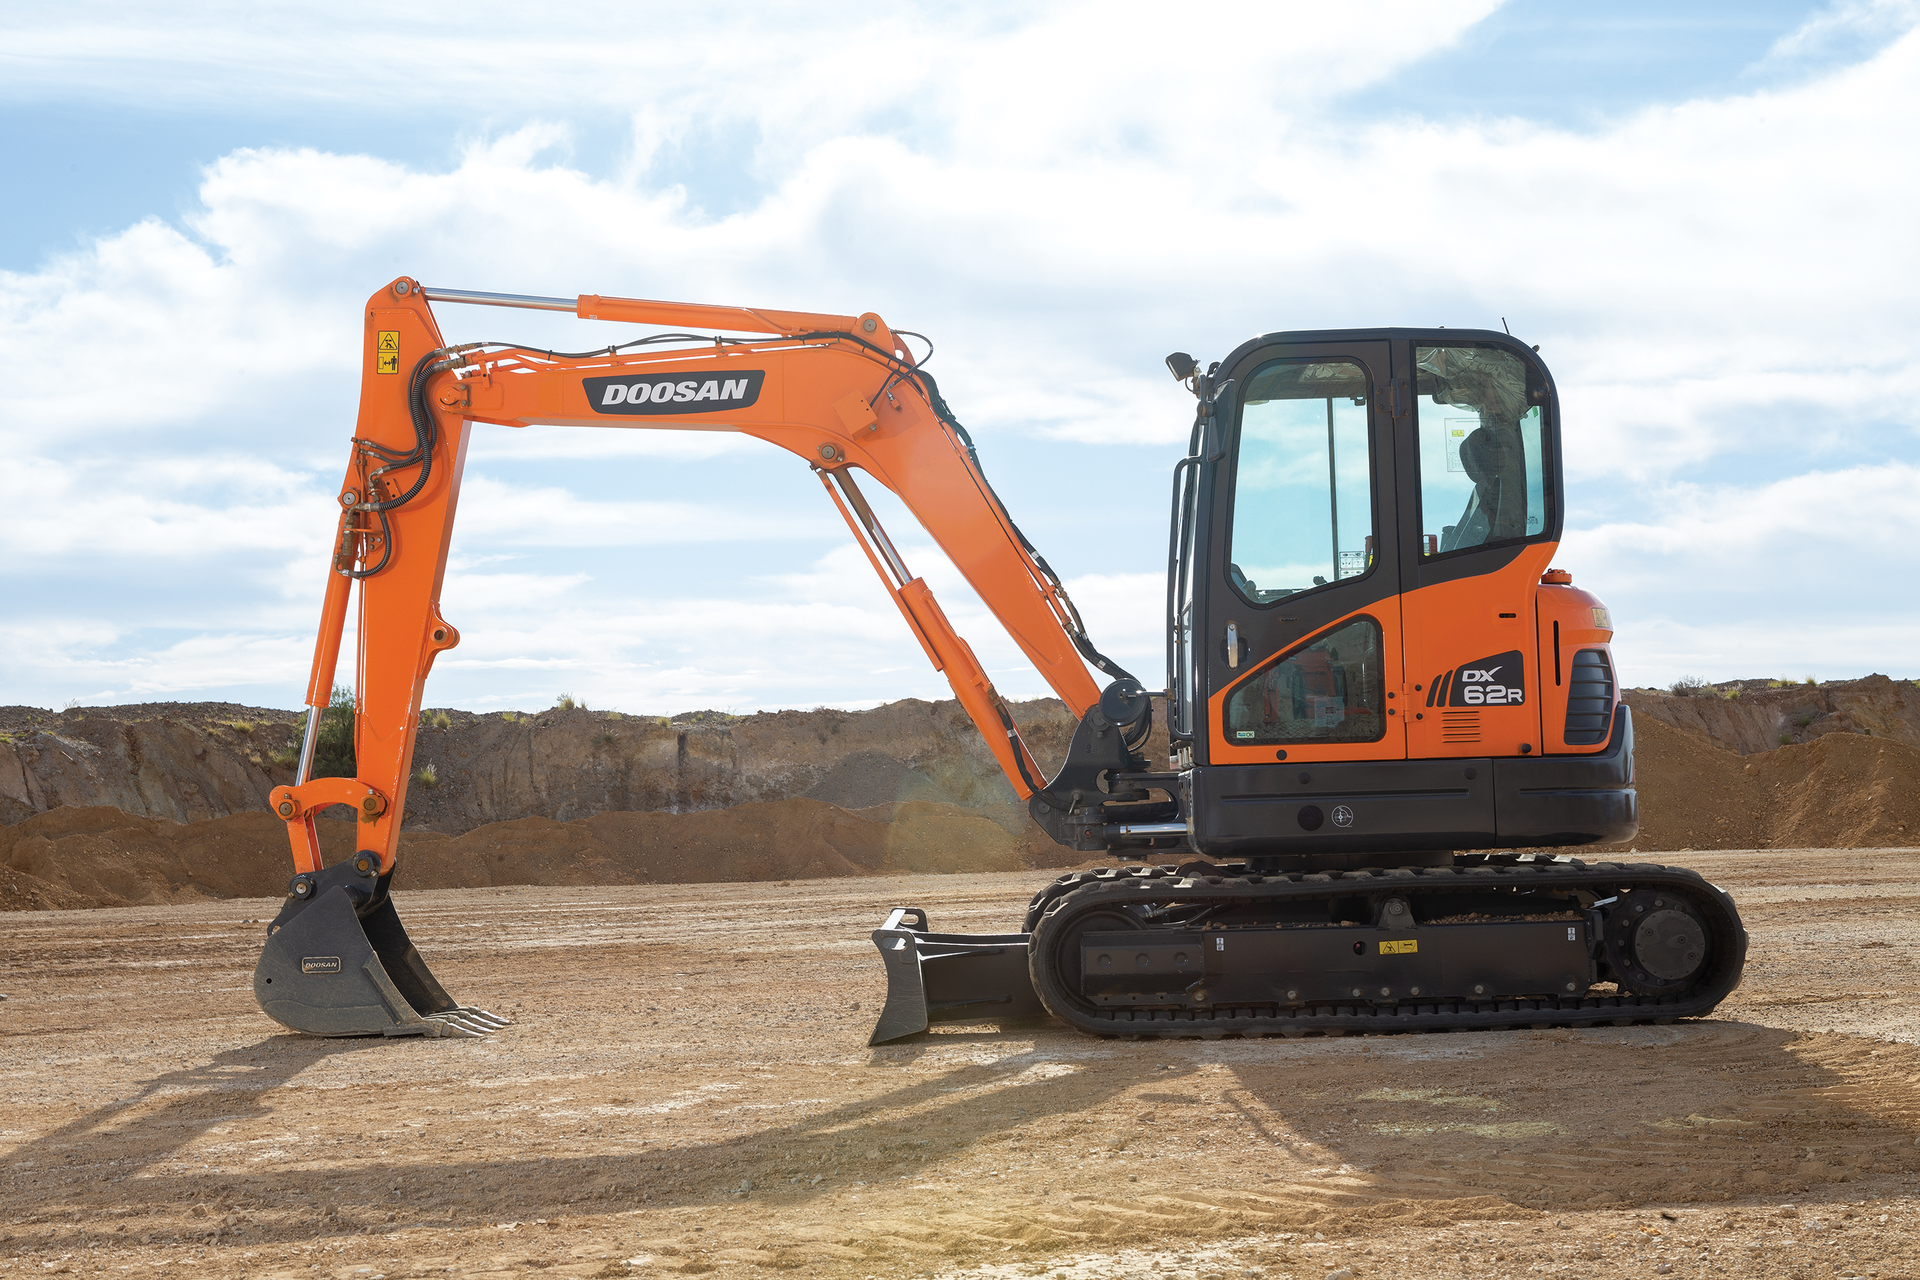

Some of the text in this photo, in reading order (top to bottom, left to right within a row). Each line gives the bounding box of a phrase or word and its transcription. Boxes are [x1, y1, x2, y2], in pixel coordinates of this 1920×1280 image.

[601, 378, 749, 406] DOOSAN
[1461, 665, 1503, 683] DX
[1463, 685, 1523, 704] 62R
